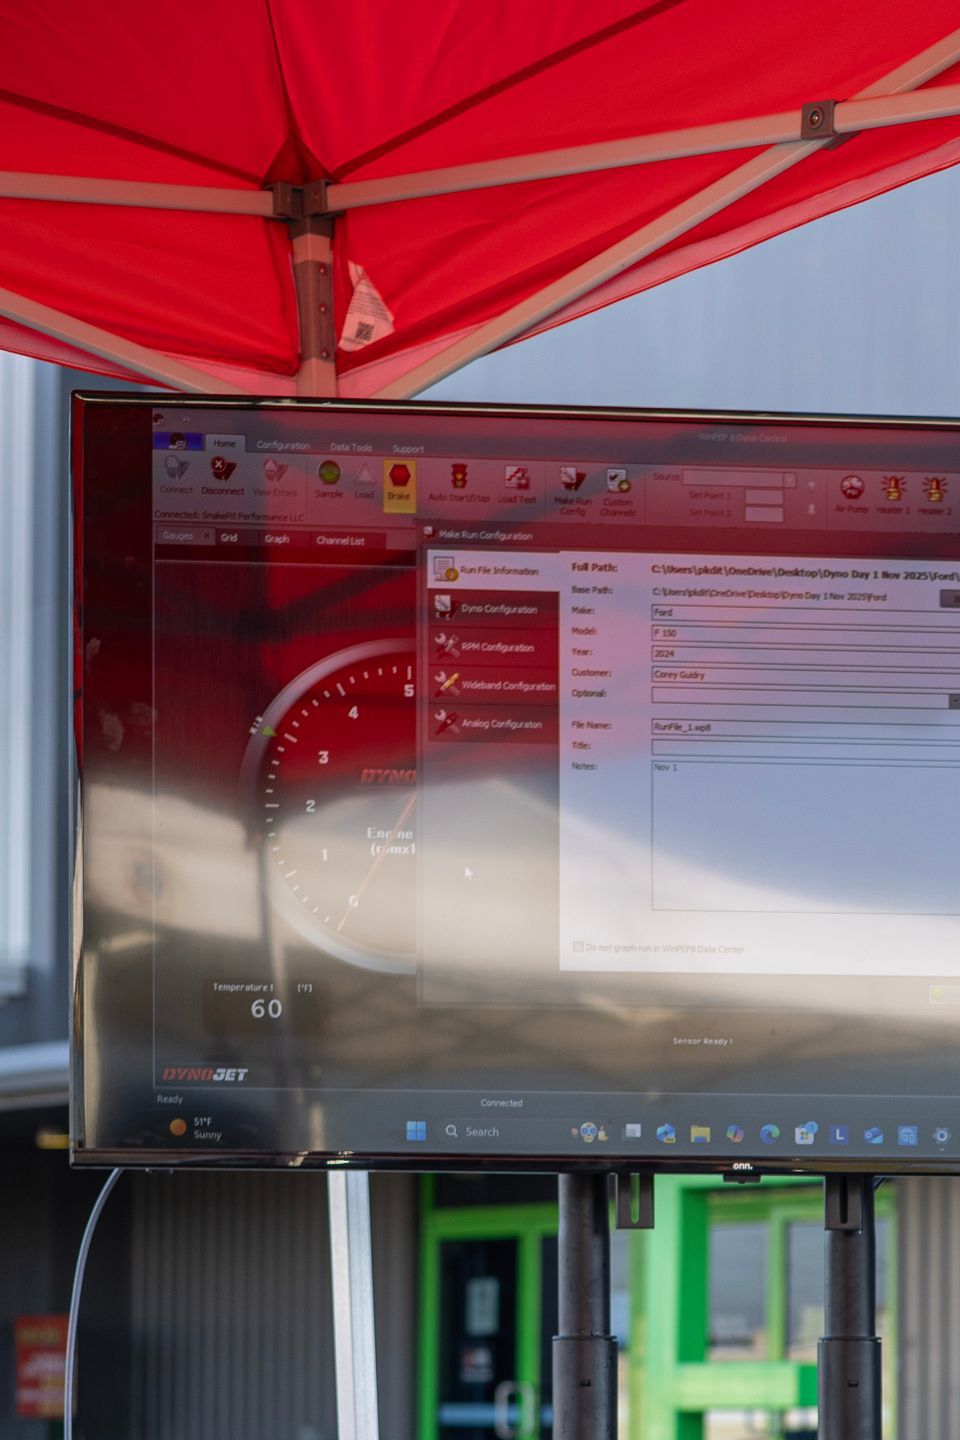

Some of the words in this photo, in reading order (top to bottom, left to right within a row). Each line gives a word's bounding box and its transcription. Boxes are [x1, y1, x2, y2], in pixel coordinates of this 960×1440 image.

[213, 439, 236, 448] Home
[256, 441, 311, 451] Configuration
[330, 443, 349, 451] Data
[350, 443, 372, 452] Tools
[392, 444, 424, 454] Support
[159, 485, 193, 495] Connect
[201, 486, 244, 496] Disconnect
[253, 487, 272, 496] View
[273, 488, 297, 498] Errors
[315, 489, 343, 499] Sample
[354, 489, 374, 499] Load
[387, 491, 411, 501] Brake
[428, 493, 448, 502] Auto
[448, 493, 490, 503] Start/Stop
[498, 495, 518, 504] Load
[519, 495, 537, 504] Test
[553, 496, 573, 505] Make
[574, 497, 592, 506] Run
[603, 498, 633, 507] Custom
[560, 507, 586, 517] Config
[600, 508, 636, 517] Channels
[877, 505, 902, 514] Heater
[154, 510, 198, 519] Connected:
[202, 511, 237, 520] SnakePit
[238, 512, 287, 521] Performance
[289, 513, 304, 521] LLC
[163, 531, 193, 542] Gauges
[220, 533, 238, 543] Grid
[264, 534, 290, 545] Graph
[316, 535, 349, 546] Channel
[350, 536, 365, 546] List
[438, 529, 459, 539] Make
[461, 531, 478, 540] Run
[479, 531, 533, 542] Configuration
[460, 566, 476, 576] Run
[477, 567, 492, 576] File
[493, 568, 539, 577] Information
[572, 562, 590, 573] Full
[591, 563, 618, 573] Path:
[851, 570, 871, 580] Day
[881, 571, 901, 580] Nov
[572, 586, 589, 595] Base
[590, 586, 613, 595] Path:
[804, 591, 821, 601] Day
[829, 592, 845, 601] Nov
[461, 604, 482, 615] Dyno
[484, 605, 538, 616] Configuration
[572, 606, 595, 615] Make:
[654, 608, 673, 617] Ford
[572, 627, 597, 636] Model:
[662, 629, 677, 638] 150
[461, 643, 479, 652] RPM
[481, 643, 534, 654] Configuration
[572, 648, 592, 657] Year:
[654, 649, 675, 658] 2024
[572, 669, 611, 678] Customer:
[654, 670, 678, 680] Corey
[403, 684, 415, 697] 5
[461, 681, 501, 691] Wideband
[503, 682, 556, 692] Configuration
[572, 689, 607, 699] Optional:
[348, 705, 359, 719] 4
[462, 719, 488, 731] Analog
[572, 721, 584, 730] File
[586, 721, 611, 730] Name:
[318, 751, 329, 764] 3
[572, 762, 597, 771] Notes:
[654, 763, 670, 772] Nov
[306, 800, 316, 813] 2
[321, 849, 329, 862] 1
[598, 944, 612, 952] not
[613, 944, 637, 953] graph
[698, 945, 717, 953] Data
[718, 946, 744, 954] Center
[213, 983, 268, 994] Temperature
[251, 998, 283, 1019] 60
[672, 1037, 702, 1046] Sensor
[703, 1037, 729, 1047] Ready
[162, 1067, 249, 1082] DYNOJET
[157, 1095, 183, 1105] Ready
[480, 1098, 523, 1108] Connected
[194, 1130, 222, 1142] Sunny
[466, 1126, 499, 1137] Search
